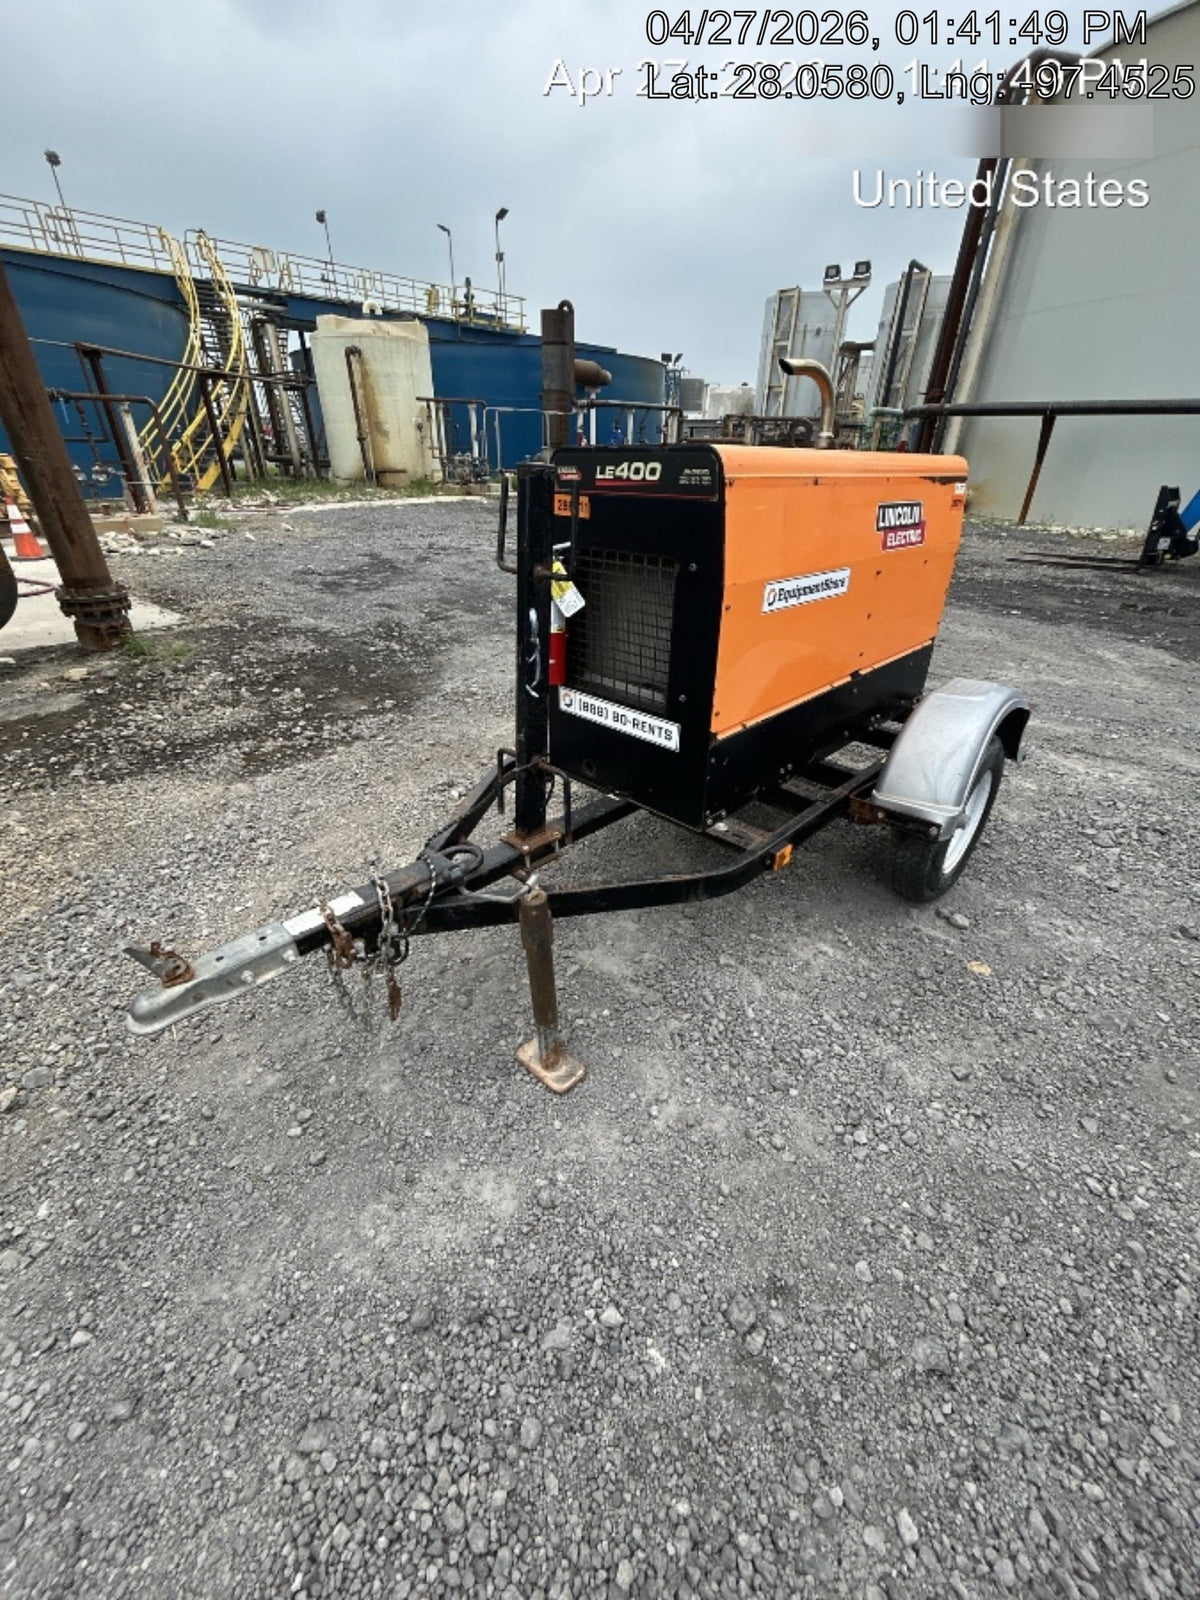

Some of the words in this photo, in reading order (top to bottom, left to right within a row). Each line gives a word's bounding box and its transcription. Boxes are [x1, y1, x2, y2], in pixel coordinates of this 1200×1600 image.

[595, 462, 662, 480] LE400
[878, 506, 920, 528] LINCOLN
[887, 529, 922, 547] ELECTRIC
[777, 577, 846, 603] EquipmentShare
